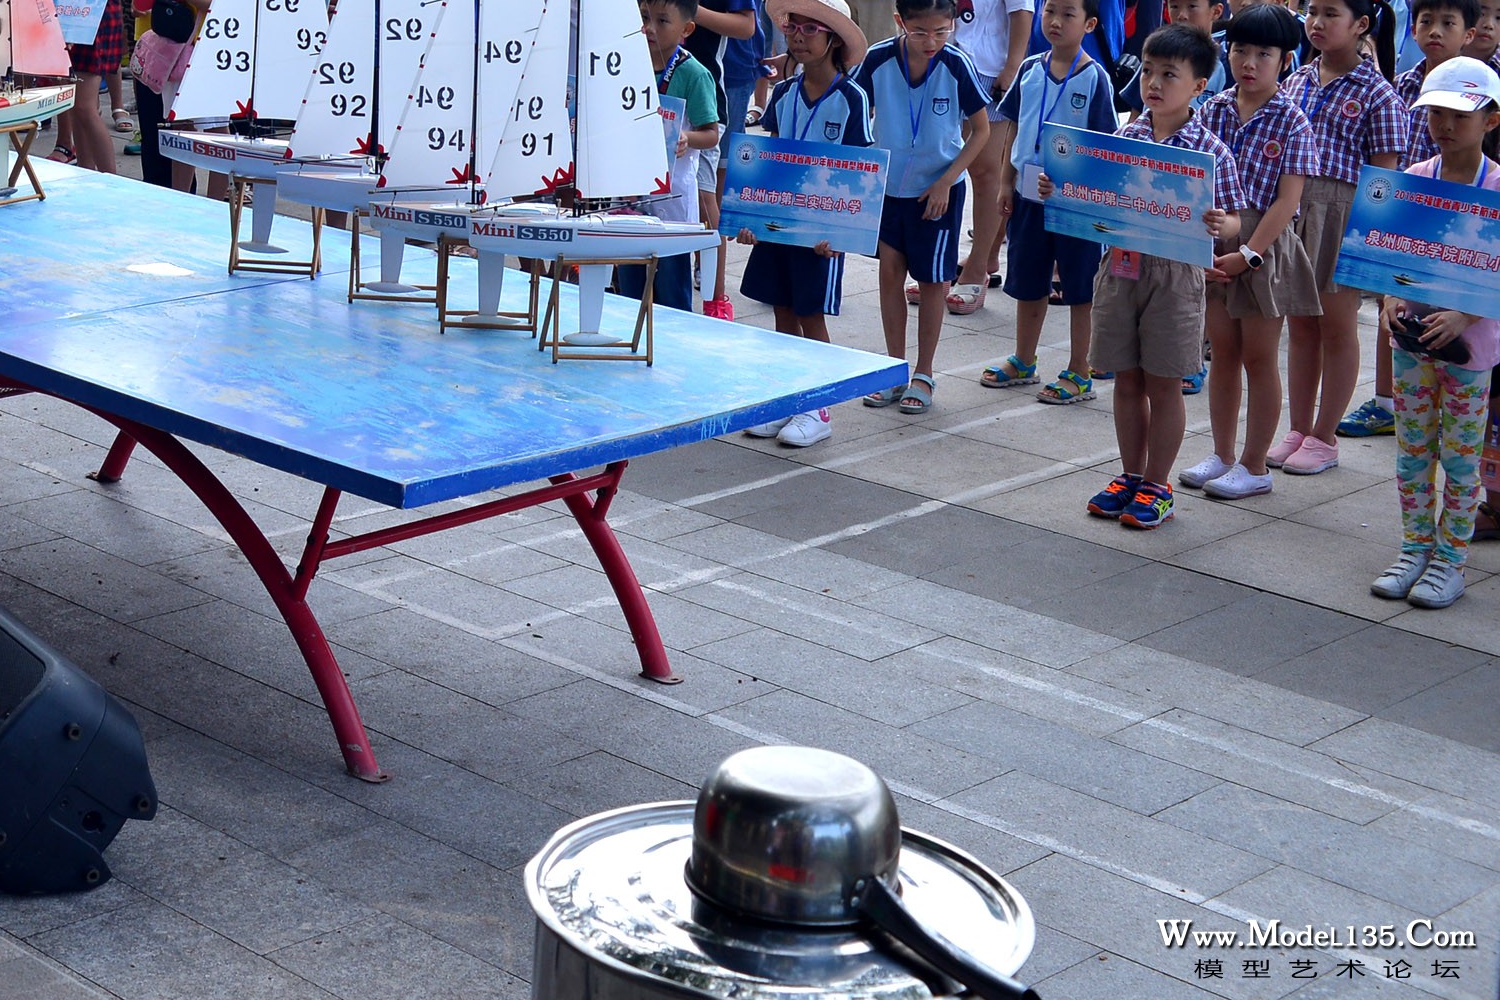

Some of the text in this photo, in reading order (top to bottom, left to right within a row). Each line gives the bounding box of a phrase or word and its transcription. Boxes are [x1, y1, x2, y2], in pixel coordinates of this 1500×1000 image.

[296, 28, 327, 53] 93
[216, 49, 250, 72] 93
[330, 94, 366, 117] 92
[621, 86, 651, 111] 91
[161, 134, 234, 160] Mini S 550
[428, 127, 466, 152] 94
[521, 132, 554, 157] 91
[739, 186, 862, 215] 泉州市第三实验小学
[1062, 182, 1191, 222] 泉州市第二中心小学
[1393, 189, 1500, 220] 2016年福建省青少年航海
[373, 205, 464, 228] Mini S 550
[472, 222, 570, 241] Mini S 550
